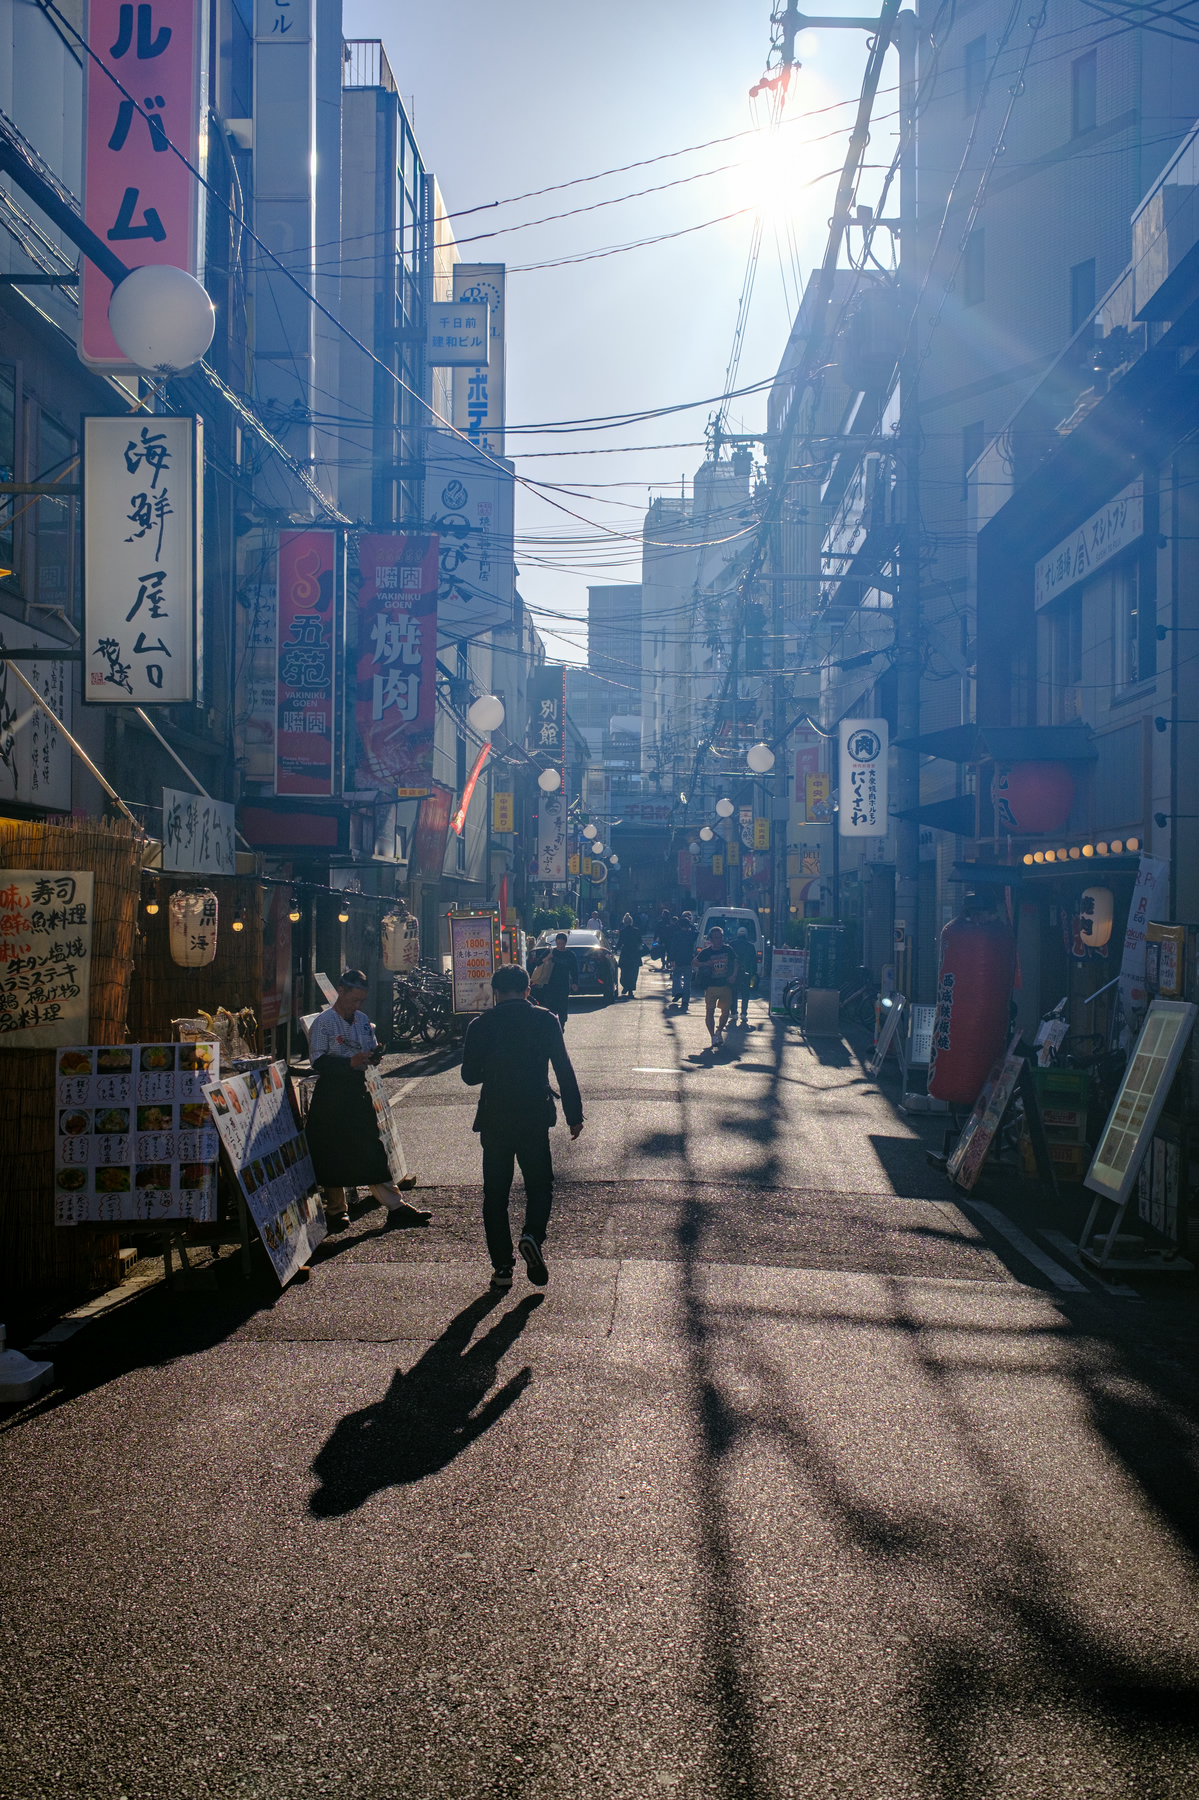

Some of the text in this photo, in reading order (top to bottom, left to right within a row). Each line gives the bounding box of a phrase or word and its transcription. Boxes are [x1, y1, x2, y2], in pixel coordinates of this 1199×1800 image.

[108, 4, 172, 243] ルバム
[432, 336, 482, 348] 建和ビル
[440, 317, 477, 329] 千日前
[123, 427, 174, 689] 海鮮屋台
[376, 592, 421, 601] YAKINIKU
[384, 601, 412, 609] GOEN
[282, 614, 331, 688] 五苑
[370, 612, 423, 722] 焼肉
[285, 691, 326, 700] YAKINIKU
[292, 699, 318, 707] GOEN
[538, 698, 559, 746] 別館
[499, 798, 508, 826] 中央通り
[850, 771, 868, 827] にくさわ
[938, 974, 954, 1049] 西成鉄板焼
